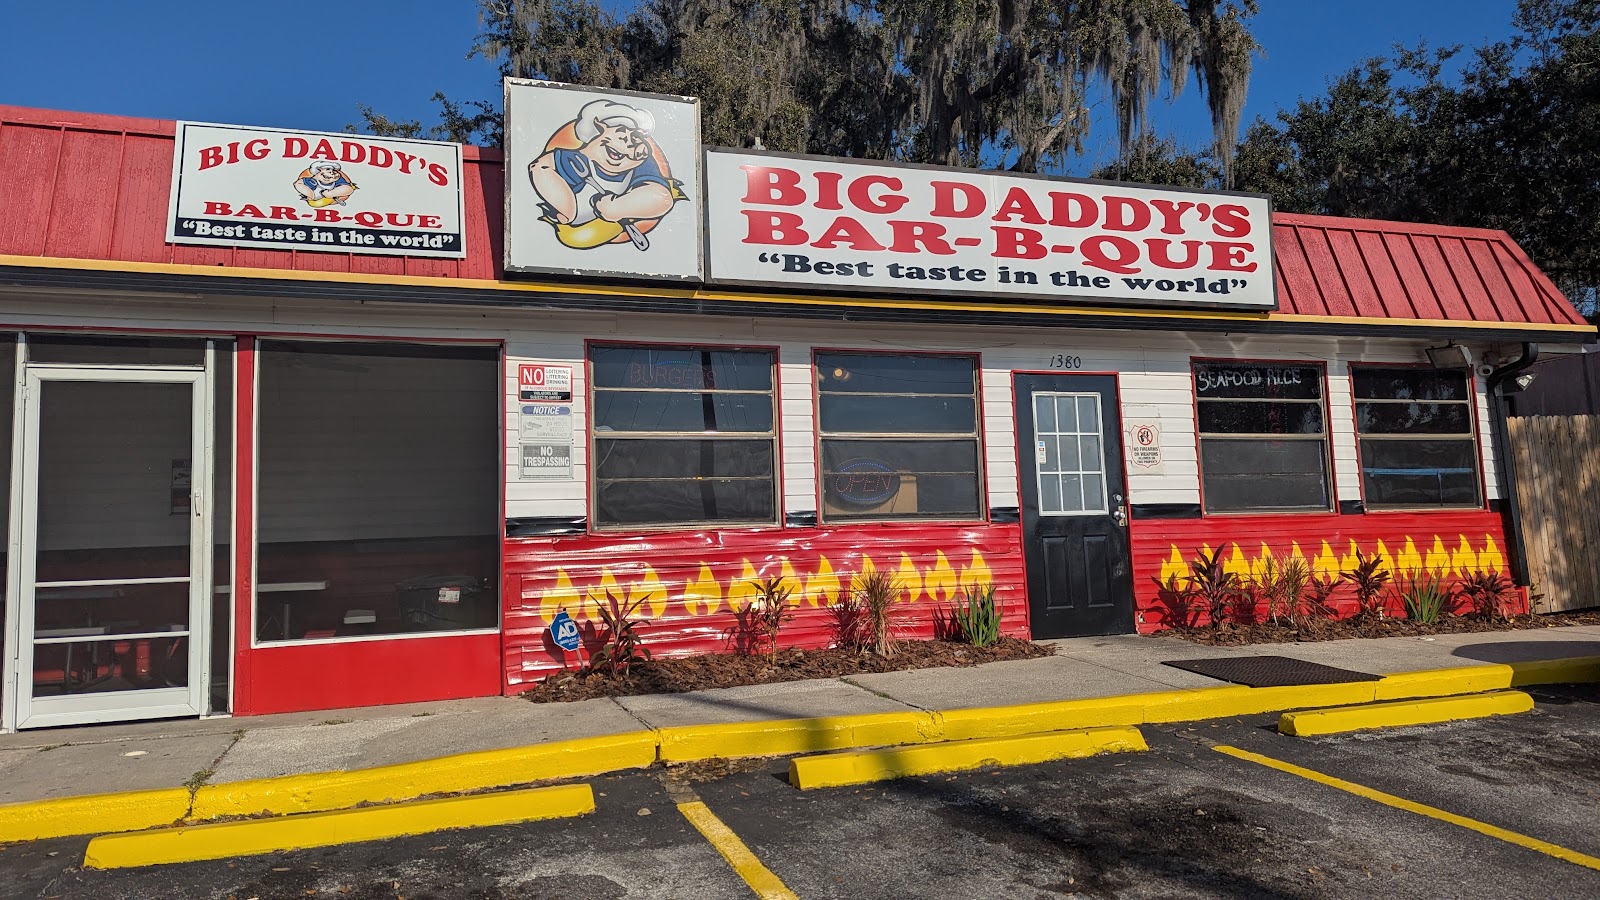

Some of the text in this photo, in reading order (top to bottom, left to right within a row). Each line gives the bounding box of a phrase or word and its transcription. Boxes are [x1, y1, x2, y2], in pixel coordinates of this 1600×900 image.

[198, 137, 449, 187] BIG DADDY'S
[740, 165, 1252, 238] BIG DADDY'S
[203, 201, 443, 229] BAR-B-QUE
[182, 220, 454, 249] “Best taste in the world”
[740, 209, 1258, 275] BAR-B-QUE
[758, 252, 1248, 295] “Best taste in the world”
[1049, 354, 1082, 369] 1380
[523, 368, 544, 385] NO
[1198, 369, 1260, 391] SEAFOOD
[533, 406, 560, 415] NOTICE
[524, 456, 570, 467] TRESPASSING
[540, 446, 553, 457] NO
[836, 470, 893, 493] OPEN
